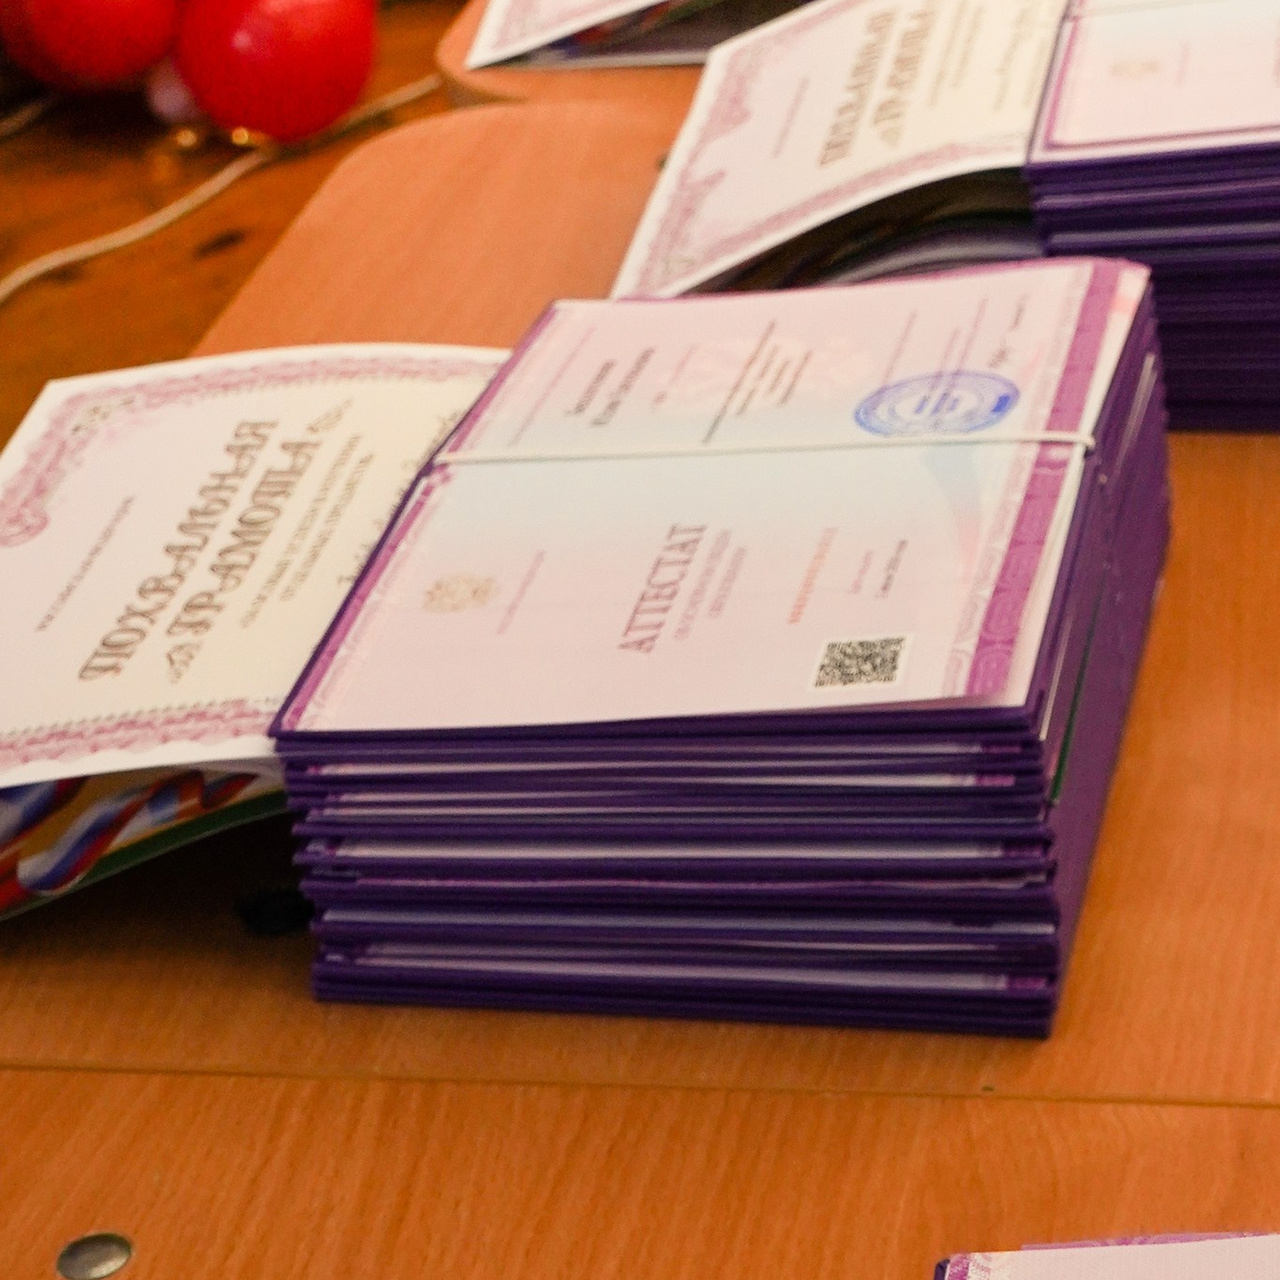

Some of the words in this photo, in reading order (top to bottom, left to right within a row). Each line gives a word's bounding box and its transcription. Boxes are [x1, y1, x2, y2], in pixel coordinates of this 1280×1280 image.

[76, 420, 280, 681] ПОХВАЛЬНАЯ
[165, 440, 321, 638] ГРАМОТА
[615, 522, 708, 654] АТТЕСТАТ
